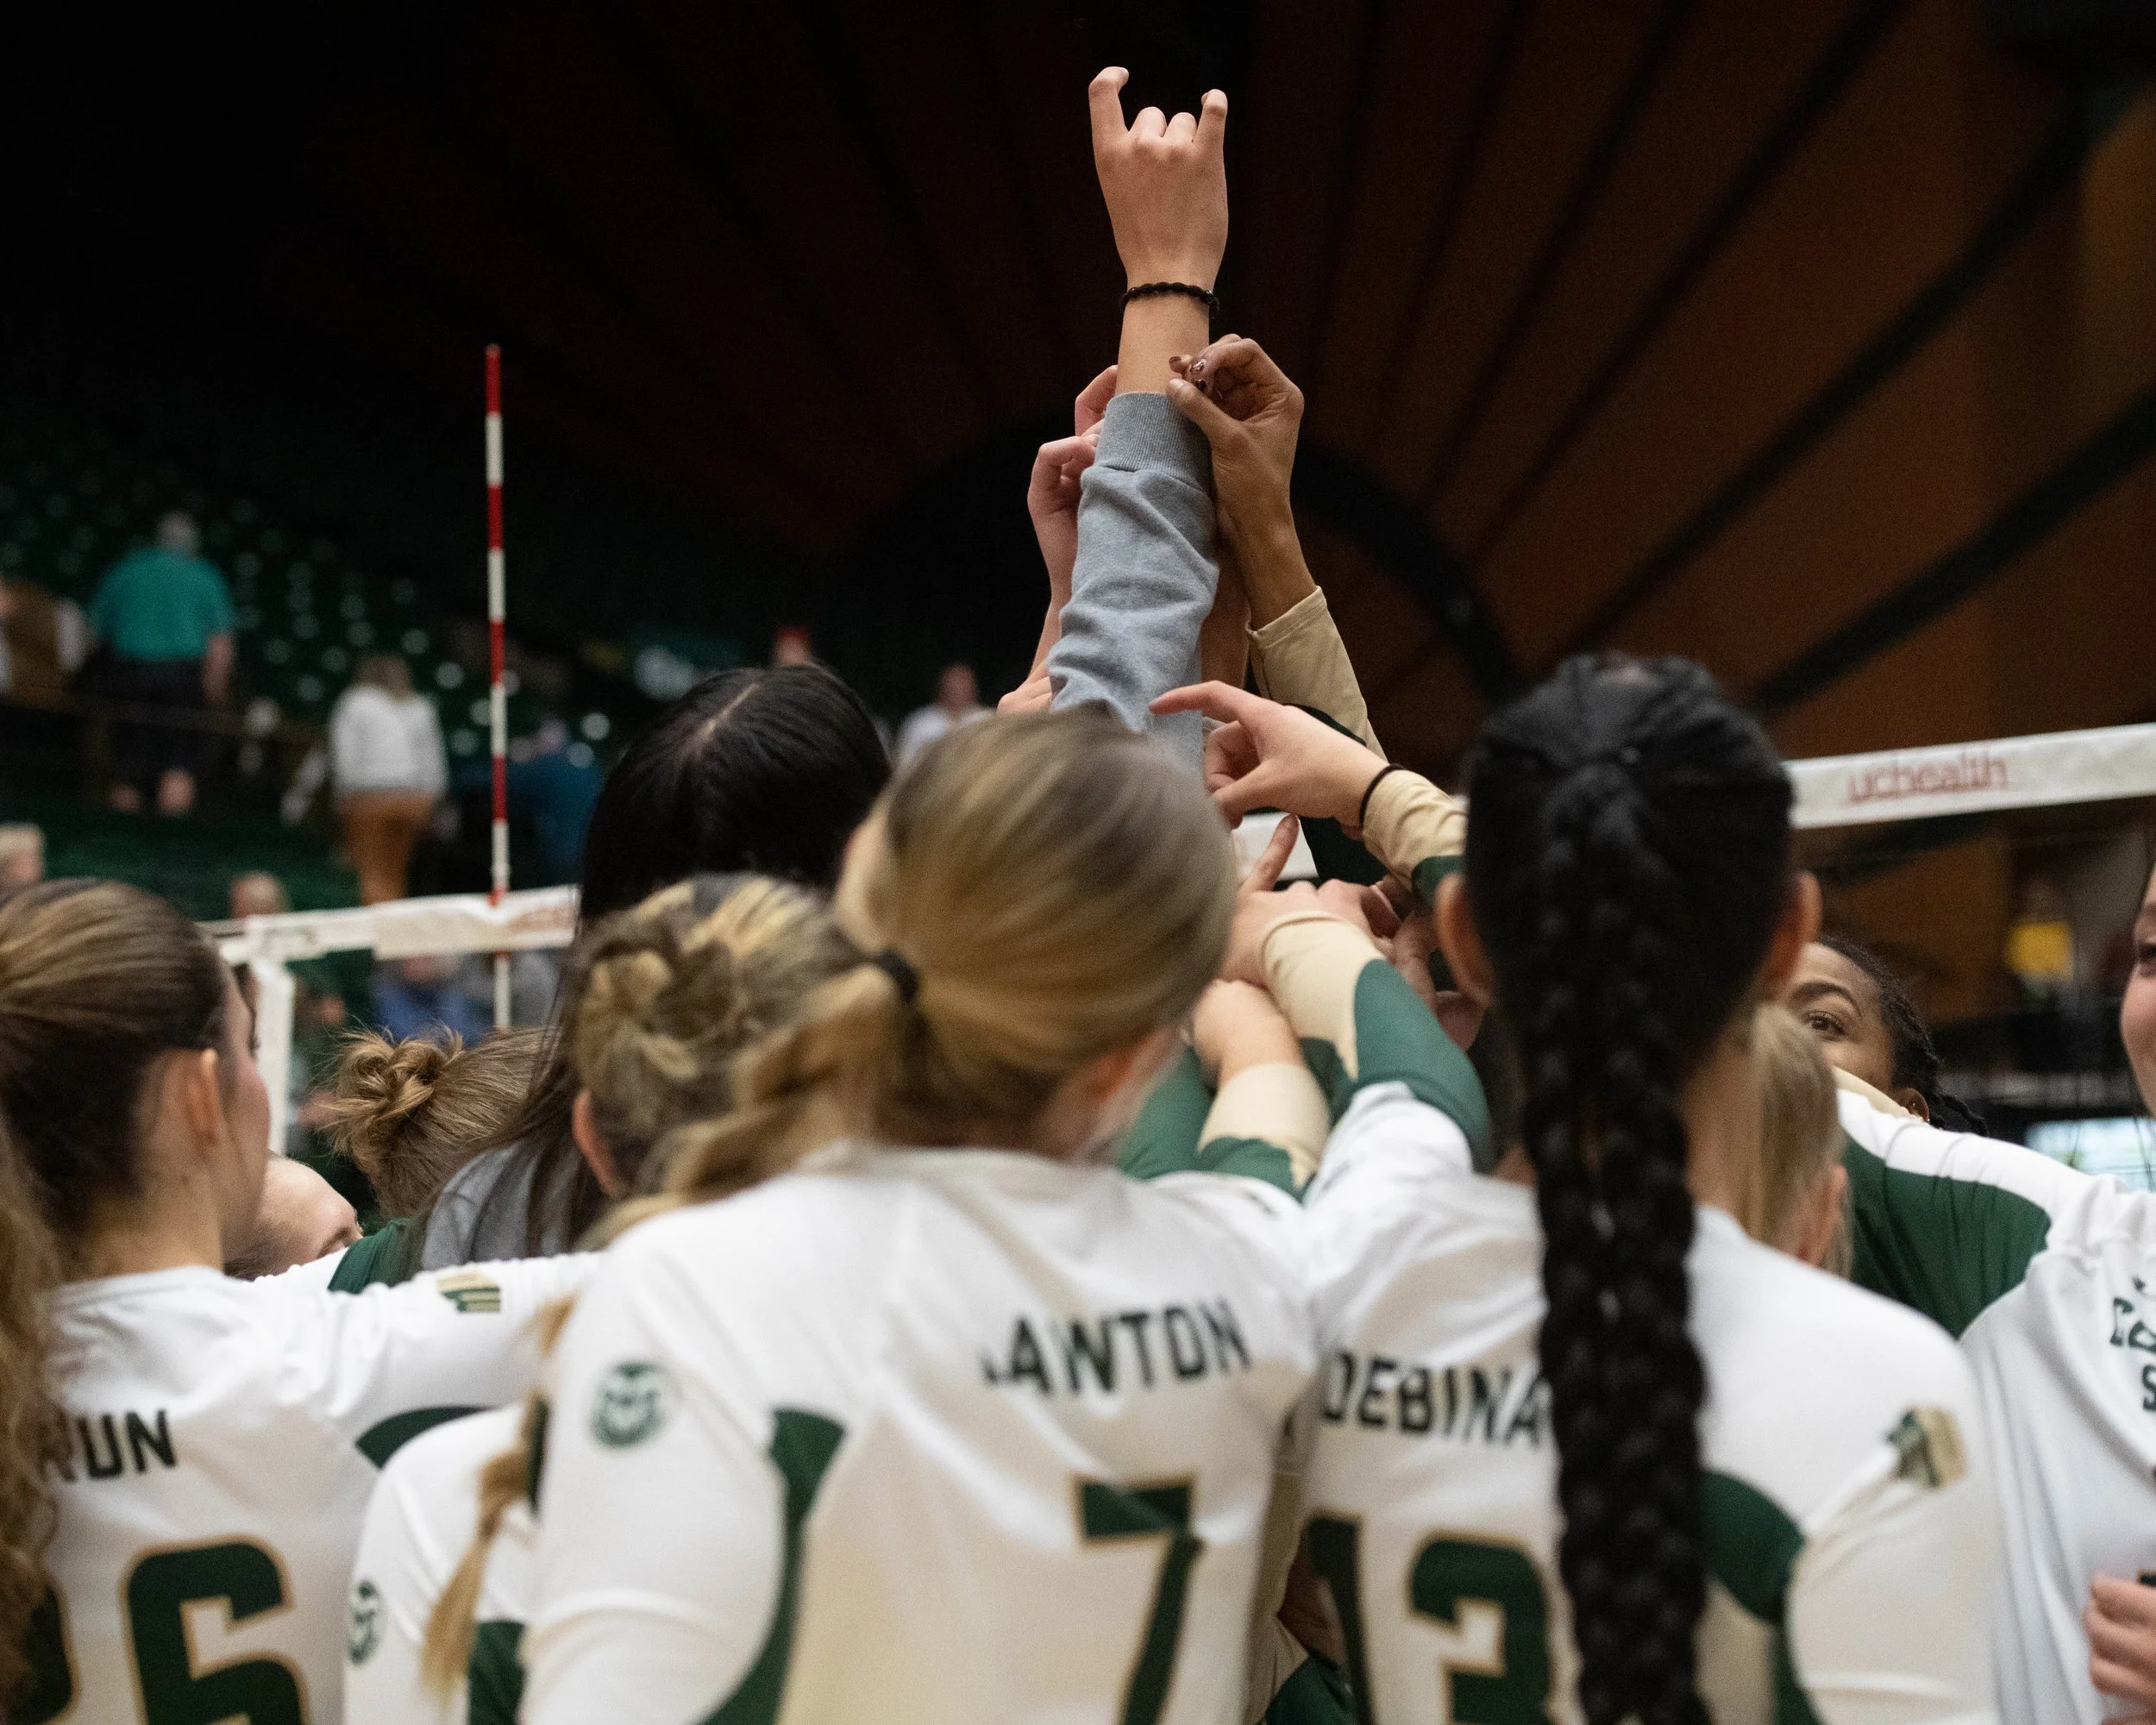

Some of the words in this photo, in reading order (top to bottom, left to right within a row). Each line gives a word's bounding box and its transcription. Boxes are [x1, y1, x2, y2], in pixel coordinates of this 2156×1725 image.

[1846, 748, 2009, 806] uchealth
[17, 1532, 317, 1725] 6
[1070, 1469, 1207, 1725] 7
